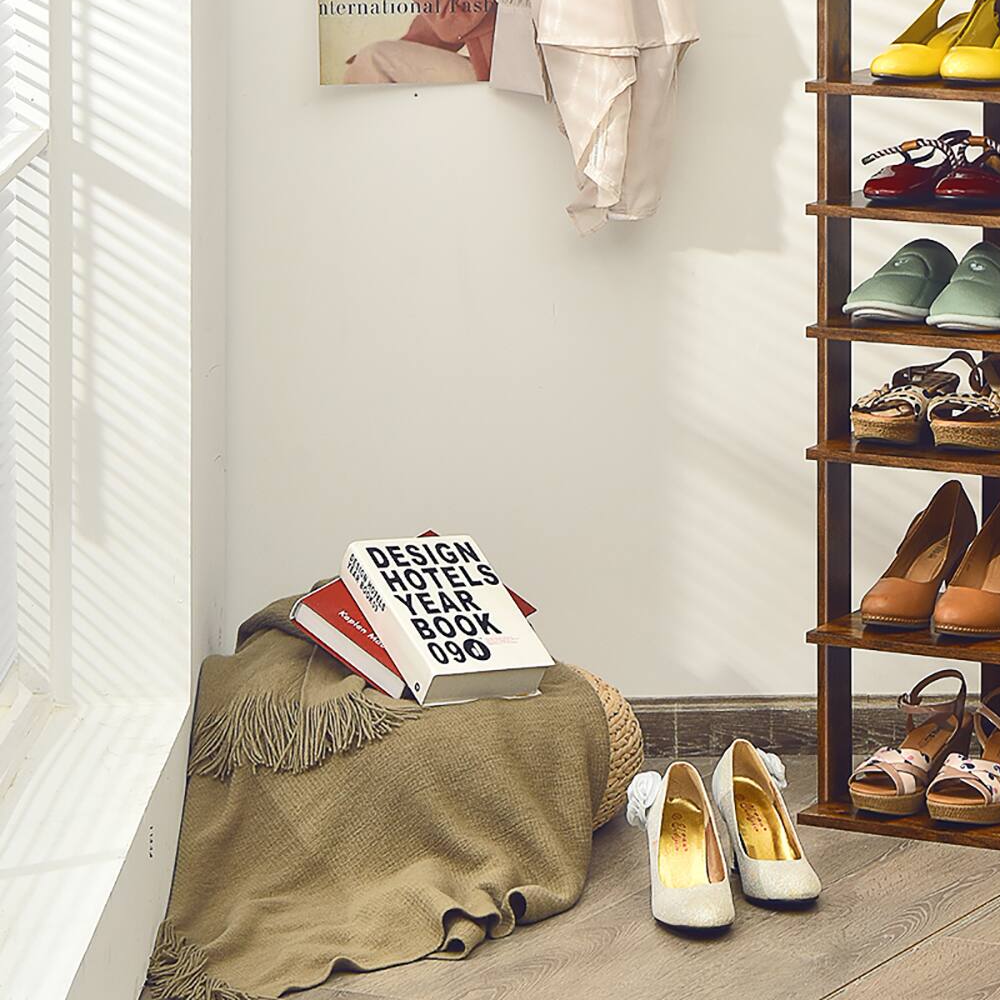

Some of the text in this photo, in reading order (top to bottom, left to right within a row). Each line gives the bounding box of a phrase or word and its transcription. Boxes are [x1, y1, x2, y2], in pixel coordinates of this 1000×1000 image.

[366, 542, 481, 568] DESIGN
[380, 564, 500, 592] HOTELS
[393, 590, 482, 616] YEAR
[410, 613, 502, 640] BOOK
[427, 640, 467, 665] 09
